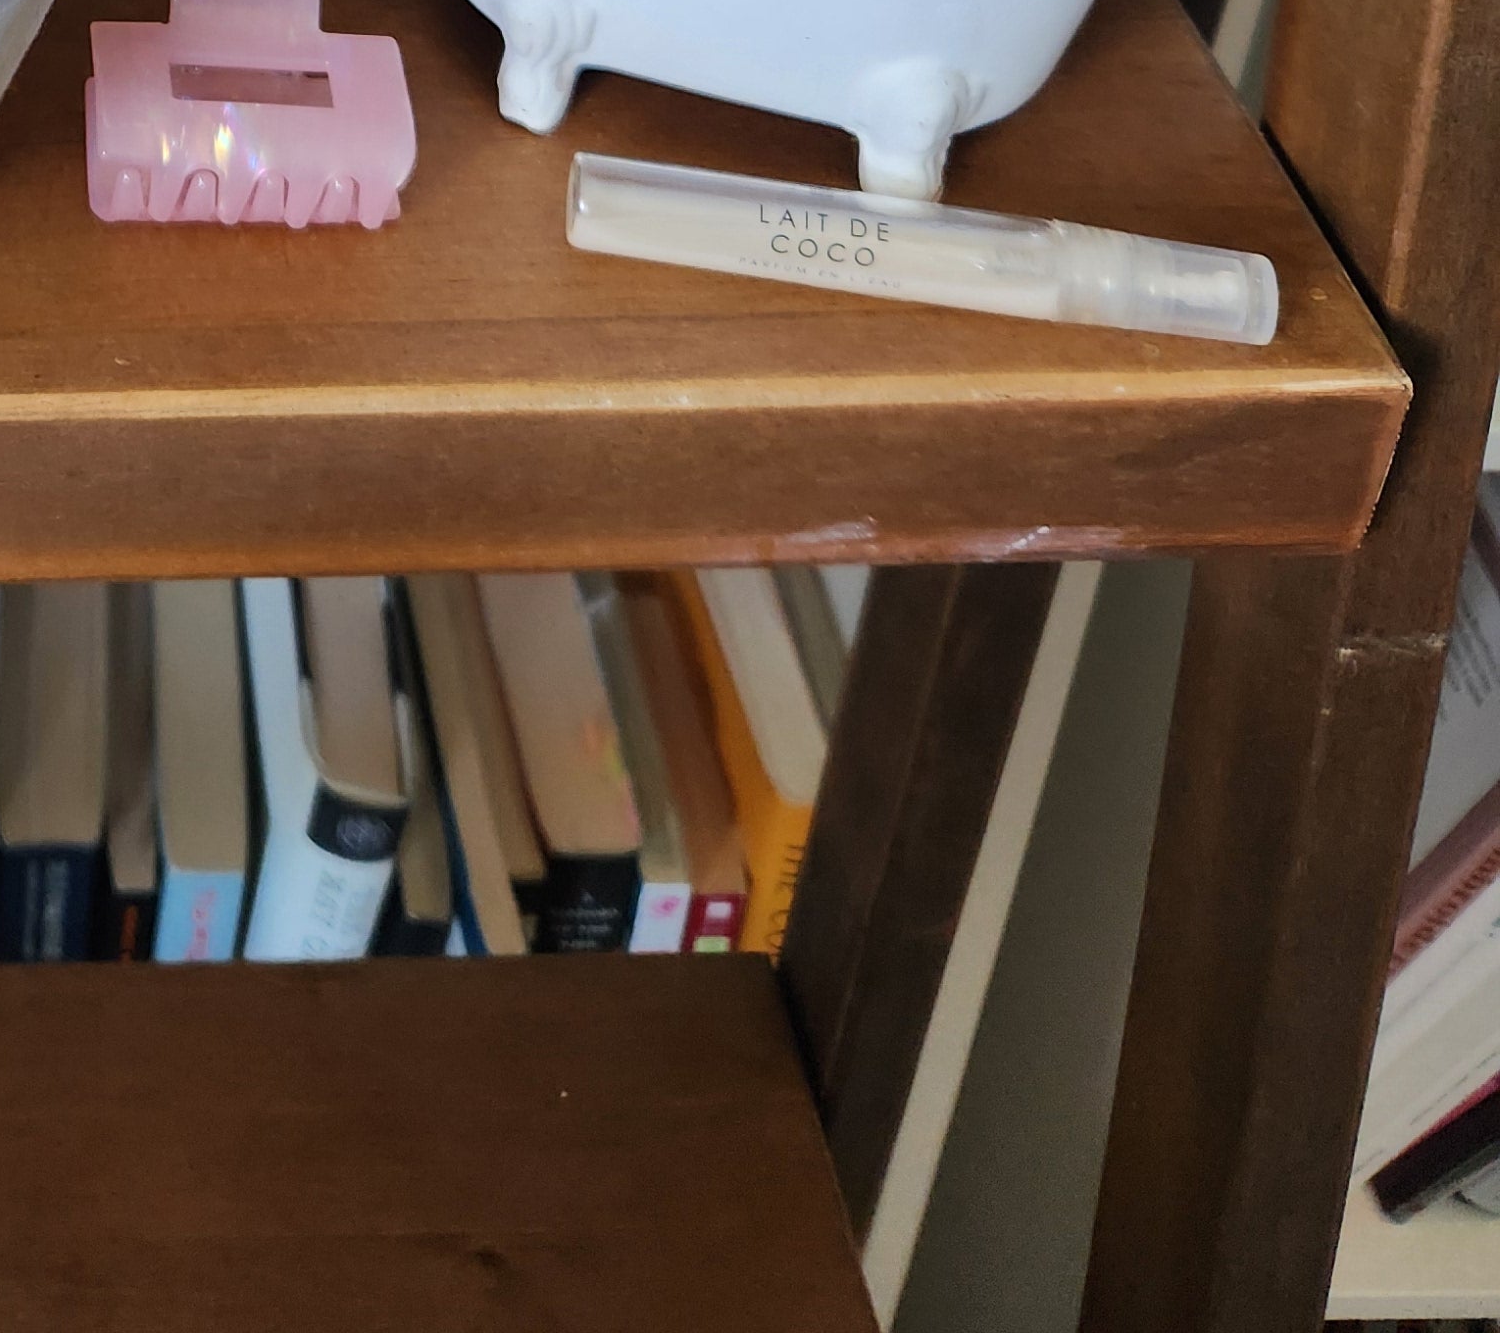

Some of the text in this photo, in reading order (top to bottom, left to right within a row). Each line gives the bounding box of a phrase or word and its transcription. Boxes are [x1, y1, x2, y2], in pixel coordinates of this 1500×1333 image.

[760, 204, 889, 242] LAIT DE
[771, 234, 875, 266] COCO
